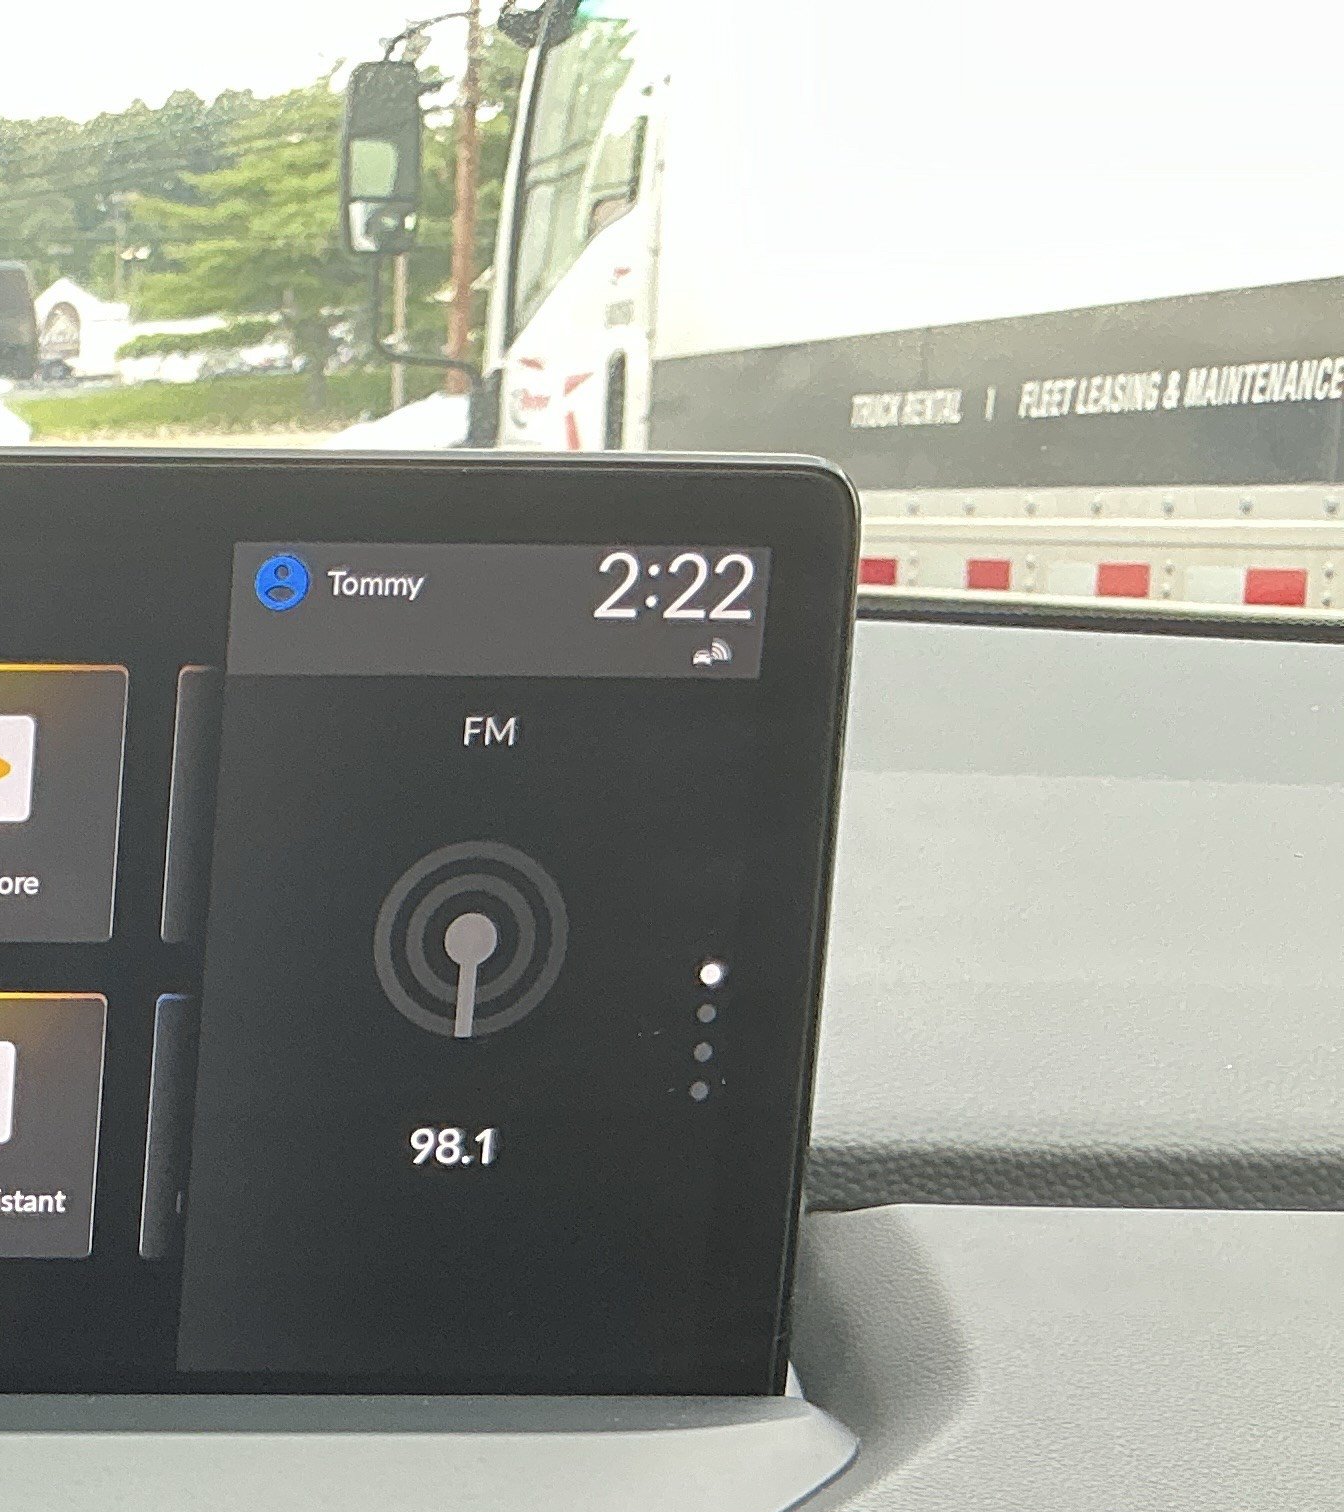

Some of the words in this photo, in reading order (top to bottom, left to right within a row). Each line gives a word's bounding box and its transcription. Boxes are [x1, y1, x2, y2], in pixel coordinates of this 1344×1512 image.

[1018, 378, 1077, 419] FLEET
[1075, 371, 1162, 415] LEASING
[1162, 370, 1181, 410] &
[1183, 357, 1344, 409] MAINTENANCE
[327, 570, 425, 601] Tommy
[593, 551, 755, 620] 2:22
[463, 716, 517, 746] FM
[410, 1127, 494, 1165] 98.1
